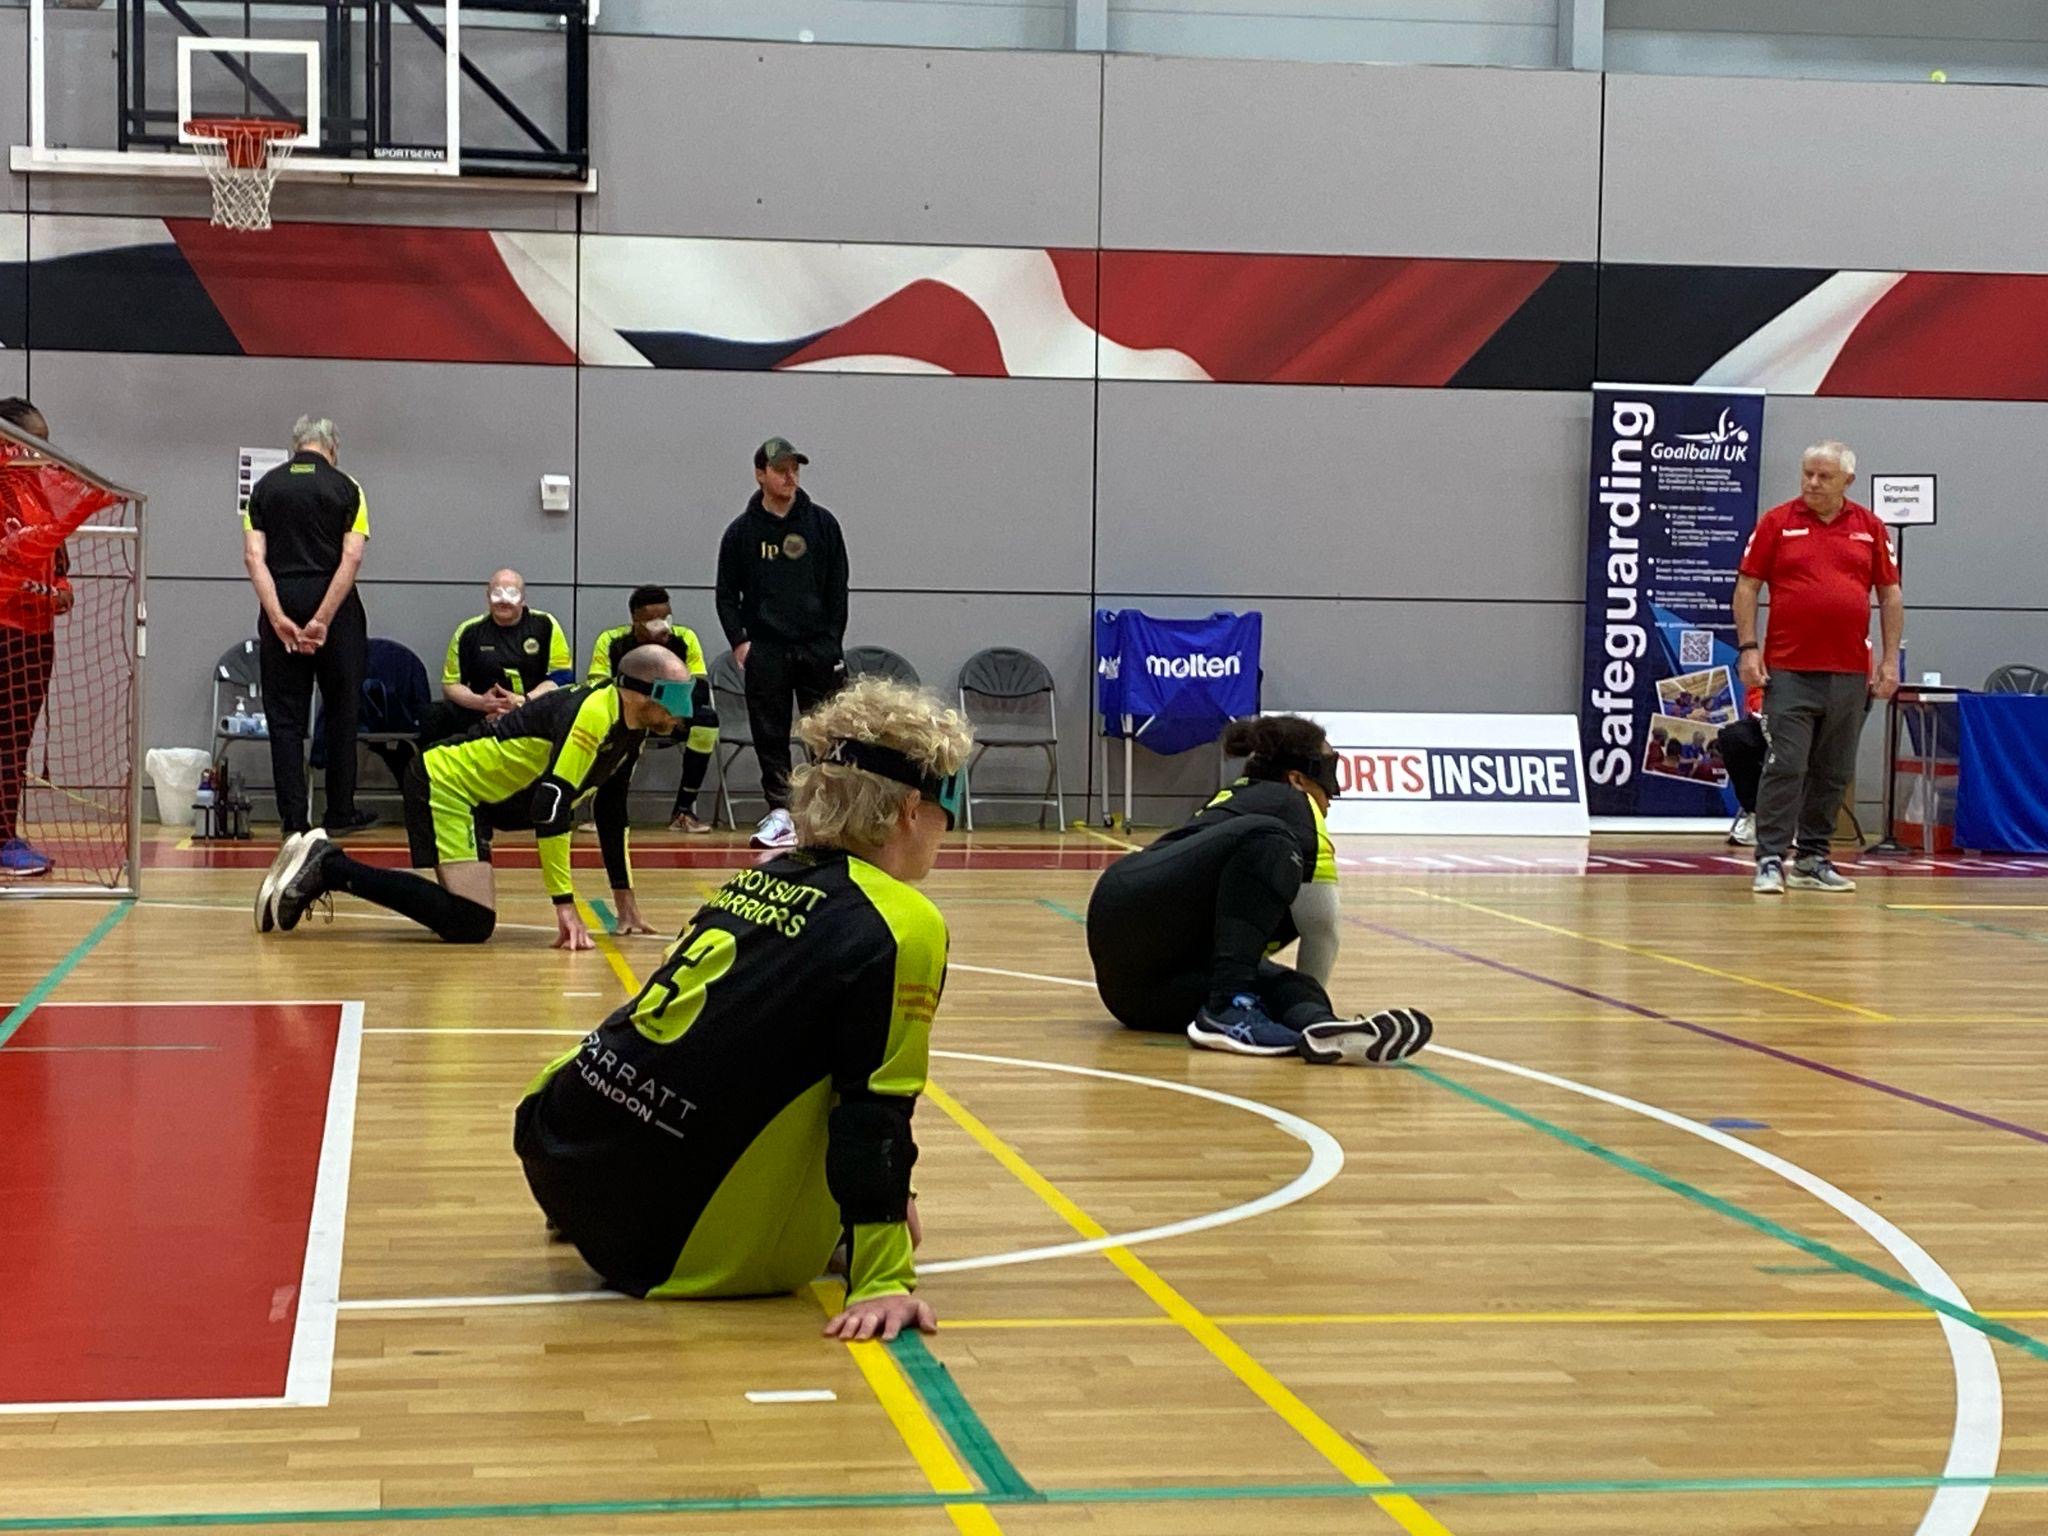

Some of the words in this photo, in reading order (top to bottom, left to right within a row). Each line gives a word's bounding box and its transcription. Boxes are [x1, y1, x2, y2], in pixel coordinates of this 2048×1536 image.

[374, 147, 445, 160] SPORTSERVE
[1650, 441, 1720, 461] Goalball
[1724, 445, 1748, 462] UK
[1883, 495, 1919, 503] Warriors
[1589, 401, 1655, 787] Safeguarding
[1145, 653, 1241, 679] molten
[1338, 754, 1425, 793] ORTS
[1431, 754, 1571, 796] INSURE
[731, 869, 828, 912] ROYSUTT
[630, 928, 737, 1045] 3
[580, 1063, 653, 1123] LONDON
